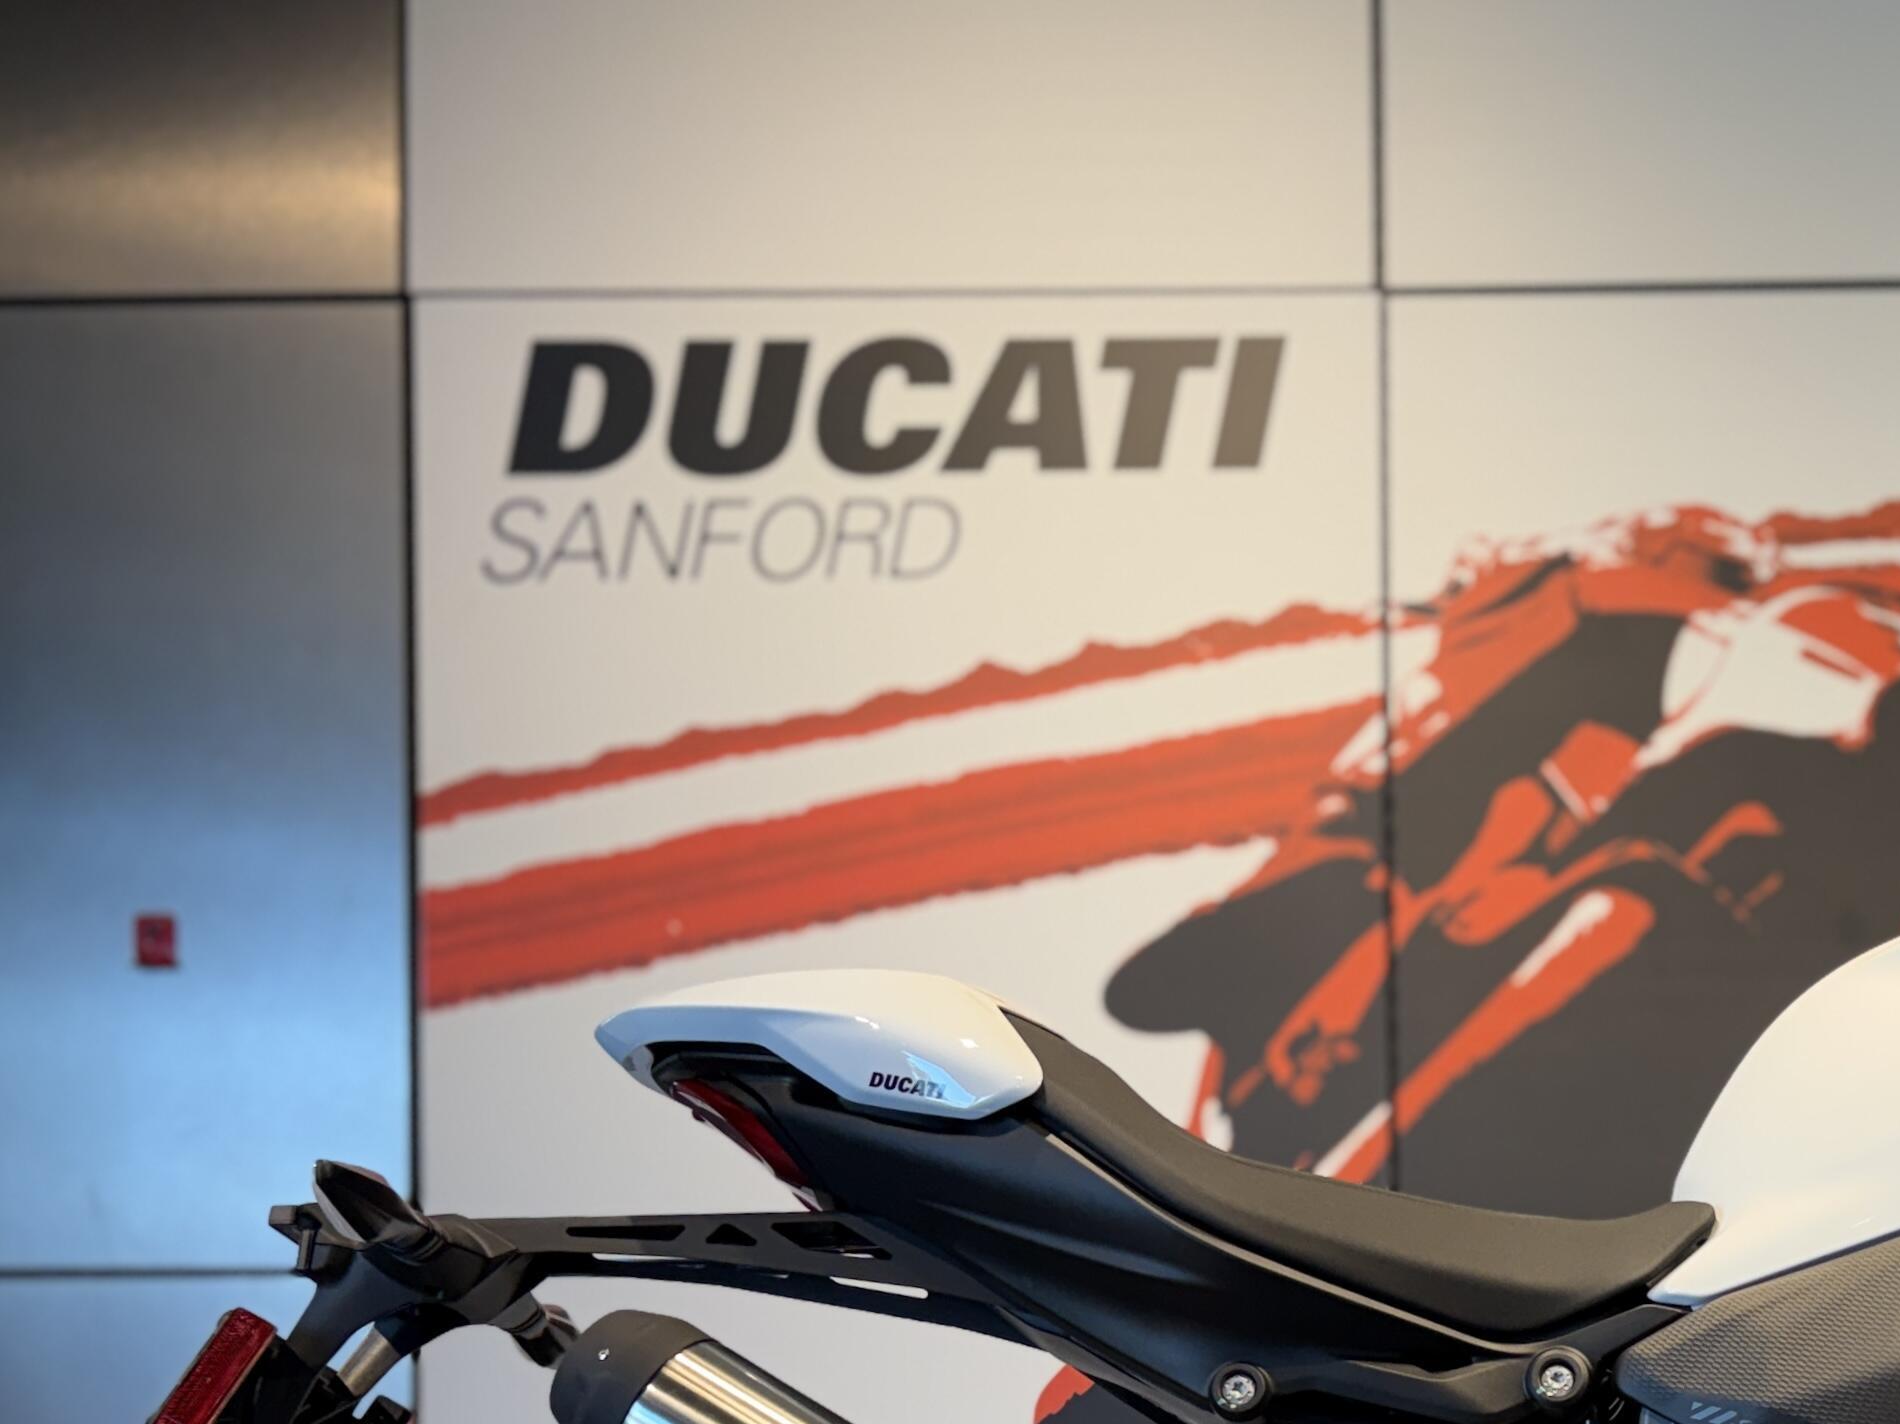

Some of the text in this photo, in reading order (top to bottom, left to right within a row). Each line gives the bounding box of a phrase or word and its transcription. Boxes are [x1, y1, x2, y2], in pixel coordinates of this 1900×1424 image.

[506, 335, 1288, 477] DUCATI
[480, 497, 962, 586] SANFORD
[868, 1071, 946, 1099] DUCATI
